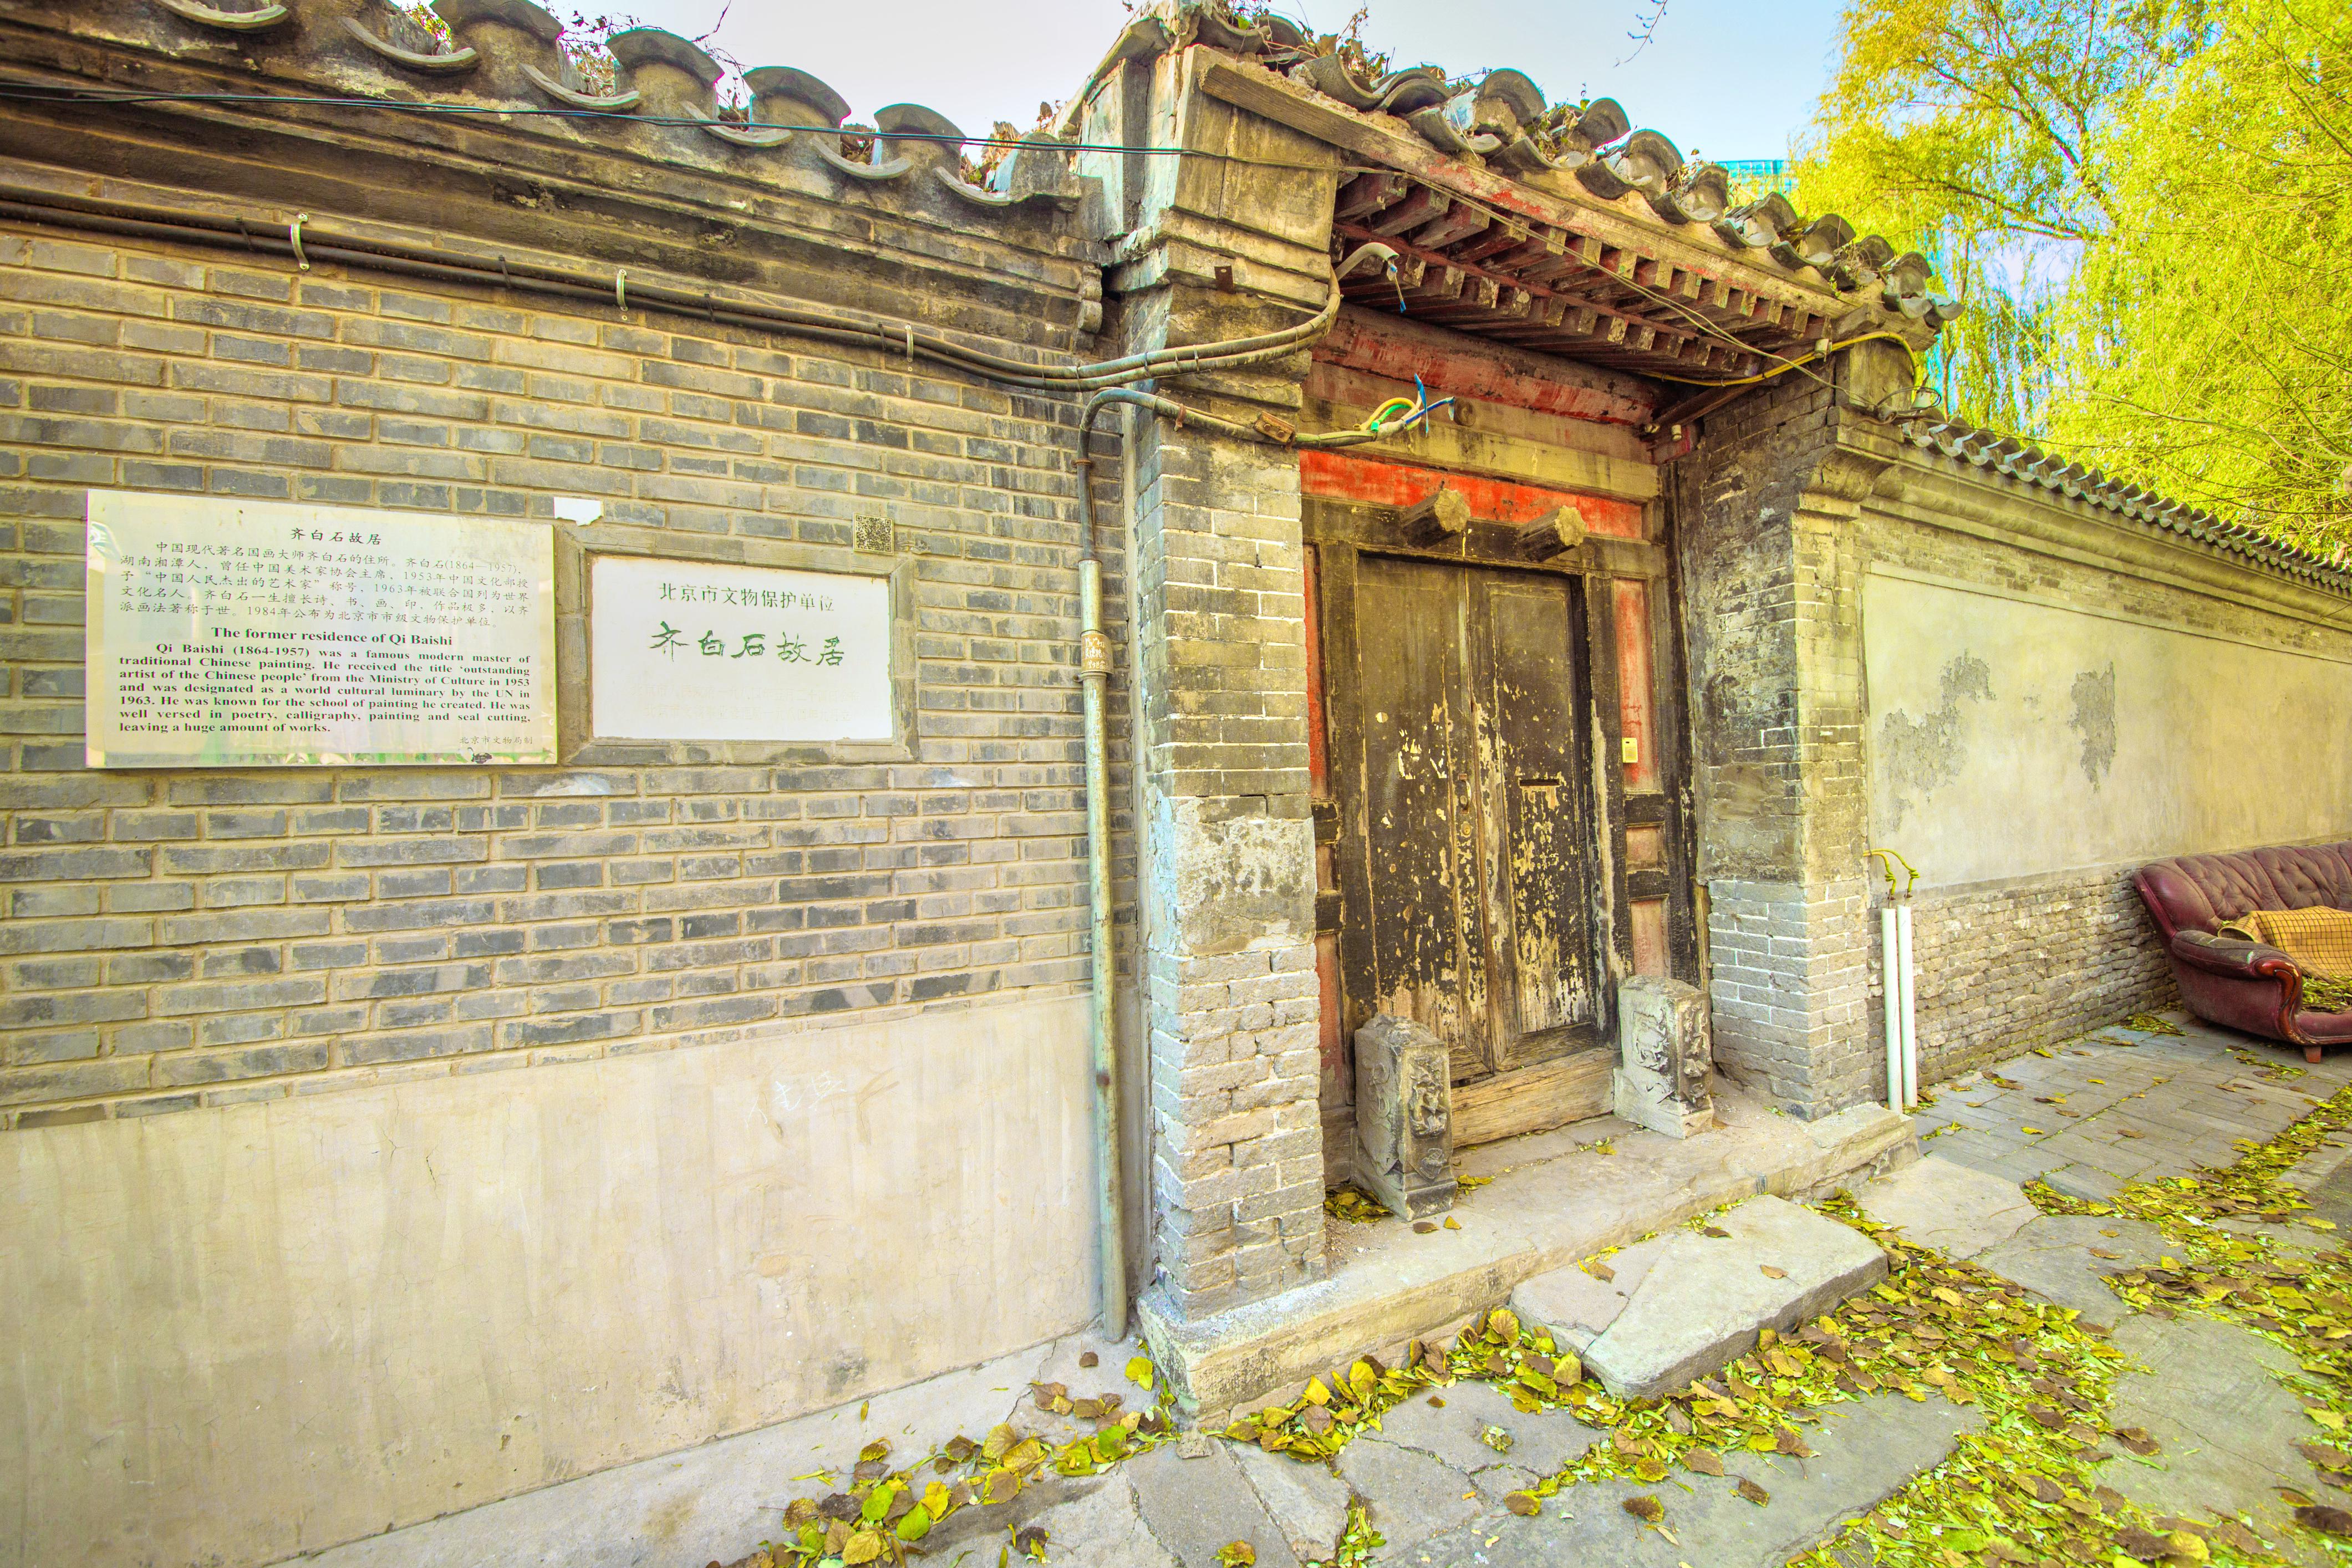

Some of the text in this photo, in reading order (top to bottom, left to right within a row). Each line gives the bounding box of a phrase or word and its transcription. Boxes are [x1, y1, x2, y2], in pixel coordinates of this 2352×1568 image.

[289, 527, 382, 545] 齐白石故居
[659, 583, 834, 612] 北京市文物保护单位
[211, 627, 452, 646] The former residence of Qi Baishi
[647, 620, 845, 666] 齐白石故居
[156, 643, 173, 654] Qi
[183, 644, 224, 654] Baishi
[233, 645, 310, 658] (1864-1957)
[366, 650, 410, 659] famous
[419, 652, 464, 661] modern
[519, 655, 531, 664] of
[119, 656, 191, 666] traditional
[200, 658, 251, 668] Chinese
[259, 659, 315, 671] painting.
[324, 661, 340, 670] He
[348, 662, 397, 671] received
[405, 663, 423, 672] the
[430, 664, 452, 673] title
[119, 669, 156, 679] artist
[161, 670, 176, 679] of
[179, 670, 200, 679] the
[205, 670, 256, 680] Chinese
[312, 673, 340, 682] from
[346, 674, 364, 683] the
[369, 674, 420, 686] Ministry
[425, 676, 437, 684] of
[441, 676, 485, 685] Culture
[490, 678, 500, 686] in
[506, 678, 530, 686] 1953
[119, 683, 145, 692] and
[184, 684, 253, 695] designated
[295, 685, 331, 695] world
[337, 686, 385, 695] cultural
[391, 687, 445, 699] luminary
[452, 689, 465, 699] by
[472, 689, 490, 698] the
[496, 689, 513, 698] UN
[520, 690, 530, 698] in
[121, 696, 155, 705] 1963.
[161, 696, 180, 705] He
[214, 696, 257, 706] known
[262, 697, 282, 706] for
[286, 698, 306, 707] the
[310, 698, 348, 707] school
[353, 699, 366, 707] of
[369, 699, 419, 710] painting
[423, 700, 436, 709] he
[440, 701, 486, 709] created.
[491, 701, 506, 710] He
[120, 709, 147, 718] well
[157, 710, 201, 719] versed
[210, 710, 222, 719] in
[232, 711, 278, 721] poetry,
[286, 711, 361, 722] calligraphy,
[369, 711, 420, 722] painting
[428, 712, 450, 721] and
[487, 714, 531, 724] cutting,
[120, 722, 169, 734] leaving
[185, 722, 216, 734] huge
[220, 724, 269, 732] amount
[273, 723, 287, 732] of
[289, 724, 330, 732] works.
[460, 736, 533, 745] 北京市文物局制
